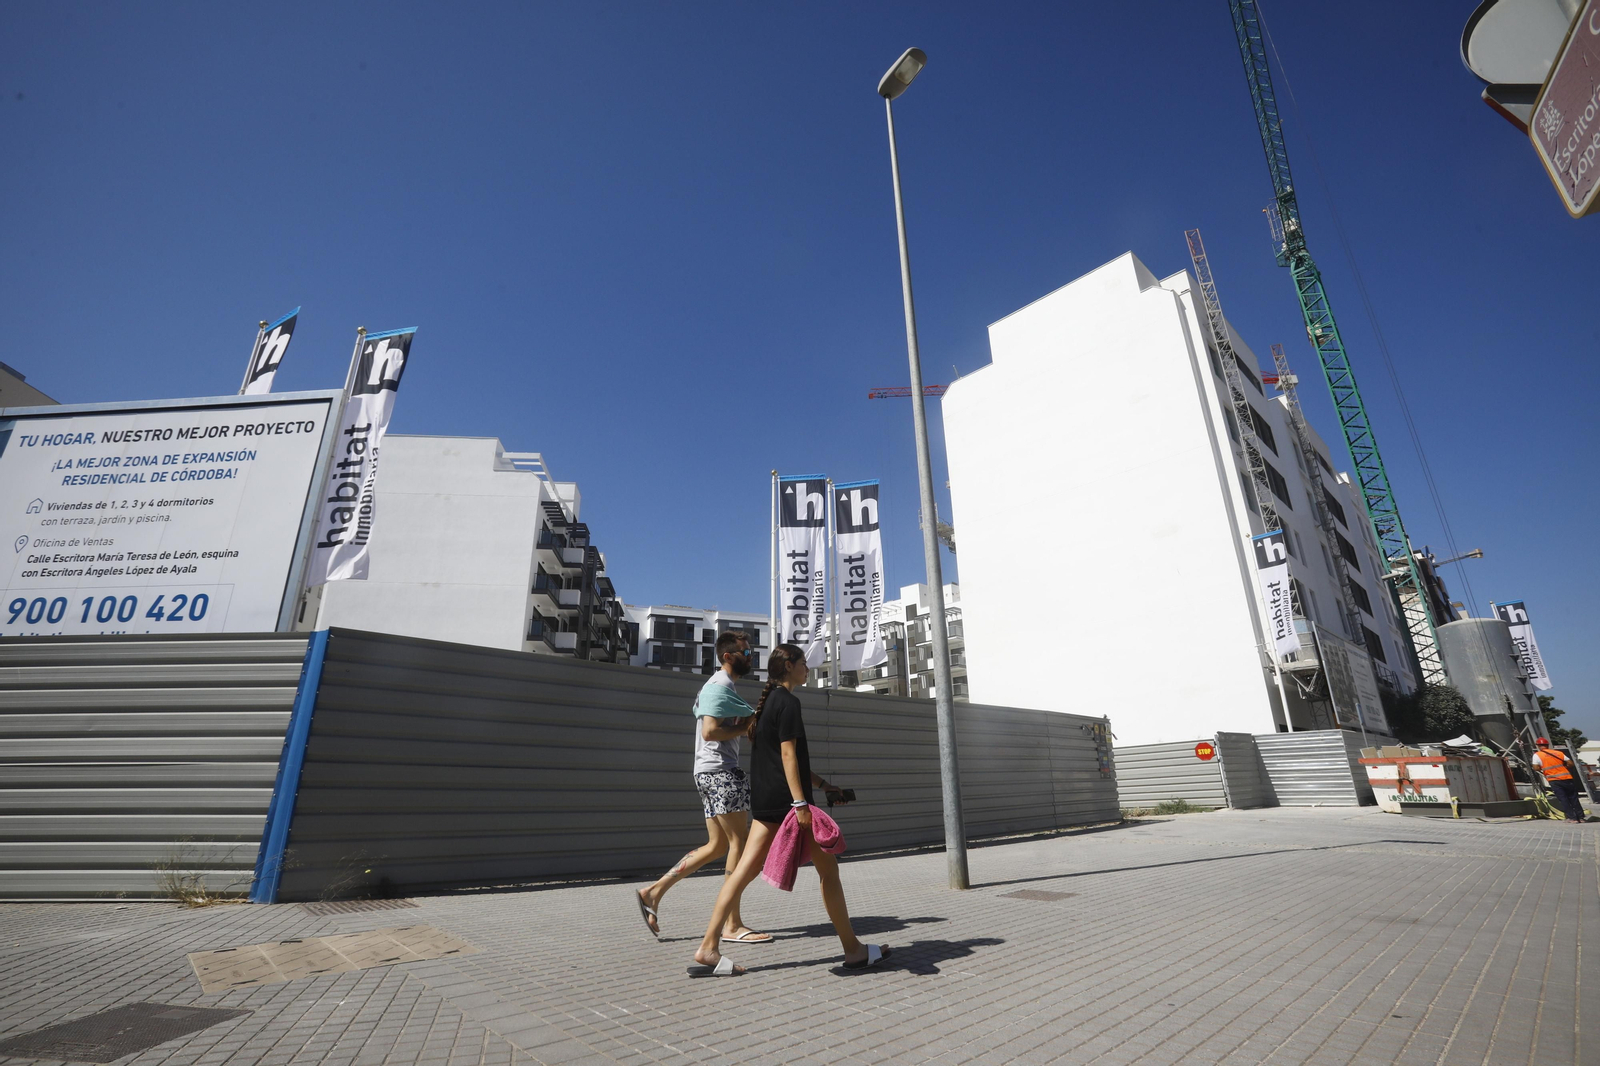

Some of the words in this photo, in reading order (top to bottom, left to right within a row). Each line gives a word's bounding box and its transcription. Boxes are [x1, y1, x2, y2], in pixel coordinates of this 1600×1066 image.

[1569, 126, 1600, 187] Lópe
[367, 338, 404, 386] h
[19, 435, 39, 448] TU
[41, 432, 96, 446] HOGAR,
[101, 428, 173, 444] NUESTRO
[176, 425, 230, 440] MEJOR
[232, 420, 315, 437] PROYECTO
[51, 459, 73, 472] ¡LA
[76, 456, 121, 469] MEJOR
[123, 455, 158, 467] ZONA
[162, 454, 180, 465] DE
[182, 448, 257, 464] EXPANSIÓN
[61, 472, 146, 486] RESIDENCIAL
[150, 472, 169, 483] DE
[171, 468, 238, 482] CÓRDOBA!
[317, 423, 372, 549] habitat
[47, 502, 93, 511] Viviendas
[95, 501, 108, 509] de
[132, 500, 138, 508] 3
[140, 501, 146, 509] y
[148, 499, 155, 507] 4
[157, 497, 214, 507] dormitorios
[349, 447, 379, 546] inmobiliaria
[795, 482, 825, 521] h
[850, 489, 879, 527] h
[41, 518, 58, 526] con
[60, 517, 96, 526] terraza,
[97, 515, 126, 526] jardín
[128, 516, 135, 525] y
[136, 514, 172, 524] piscina.
[27, 554, 51, 563] Calle
[52, 553, 94, 563] Escritora
[97, 552, 124, 562] María
[127, 552, 157, 560] Teresa
[159, 551, 171, 560] de
[173, 550, 199, 560] León,
[201, 549, 239, 560] esquina
[33, 538, 66, 548] Oficina
[68, 538, 80, 547] de
[83, 538, 114, 546] Ventas
[1263, 537, 1287, 563] h
[22, 570, 38, 578] con
[40, 567, 83, 577] Escritora
[84, 565, 123, 578] Ángeles
[126, 565, 154, 576] López
[156, 565, 168, 574] de
[170, 564, 197, 575] Ayala
[6, 596, 68, 624] 900
[80, 595, 138, 623] 100
[145, 594, 209, 622] 420
[787, 550, 810, 644] habitat
[812, 570, 824, 642] inmobiliaria
[844, 554, 868, 645] habitat
[1267, 580, 1286, 641] habitat
[1506, 605, 1528, 623] h
